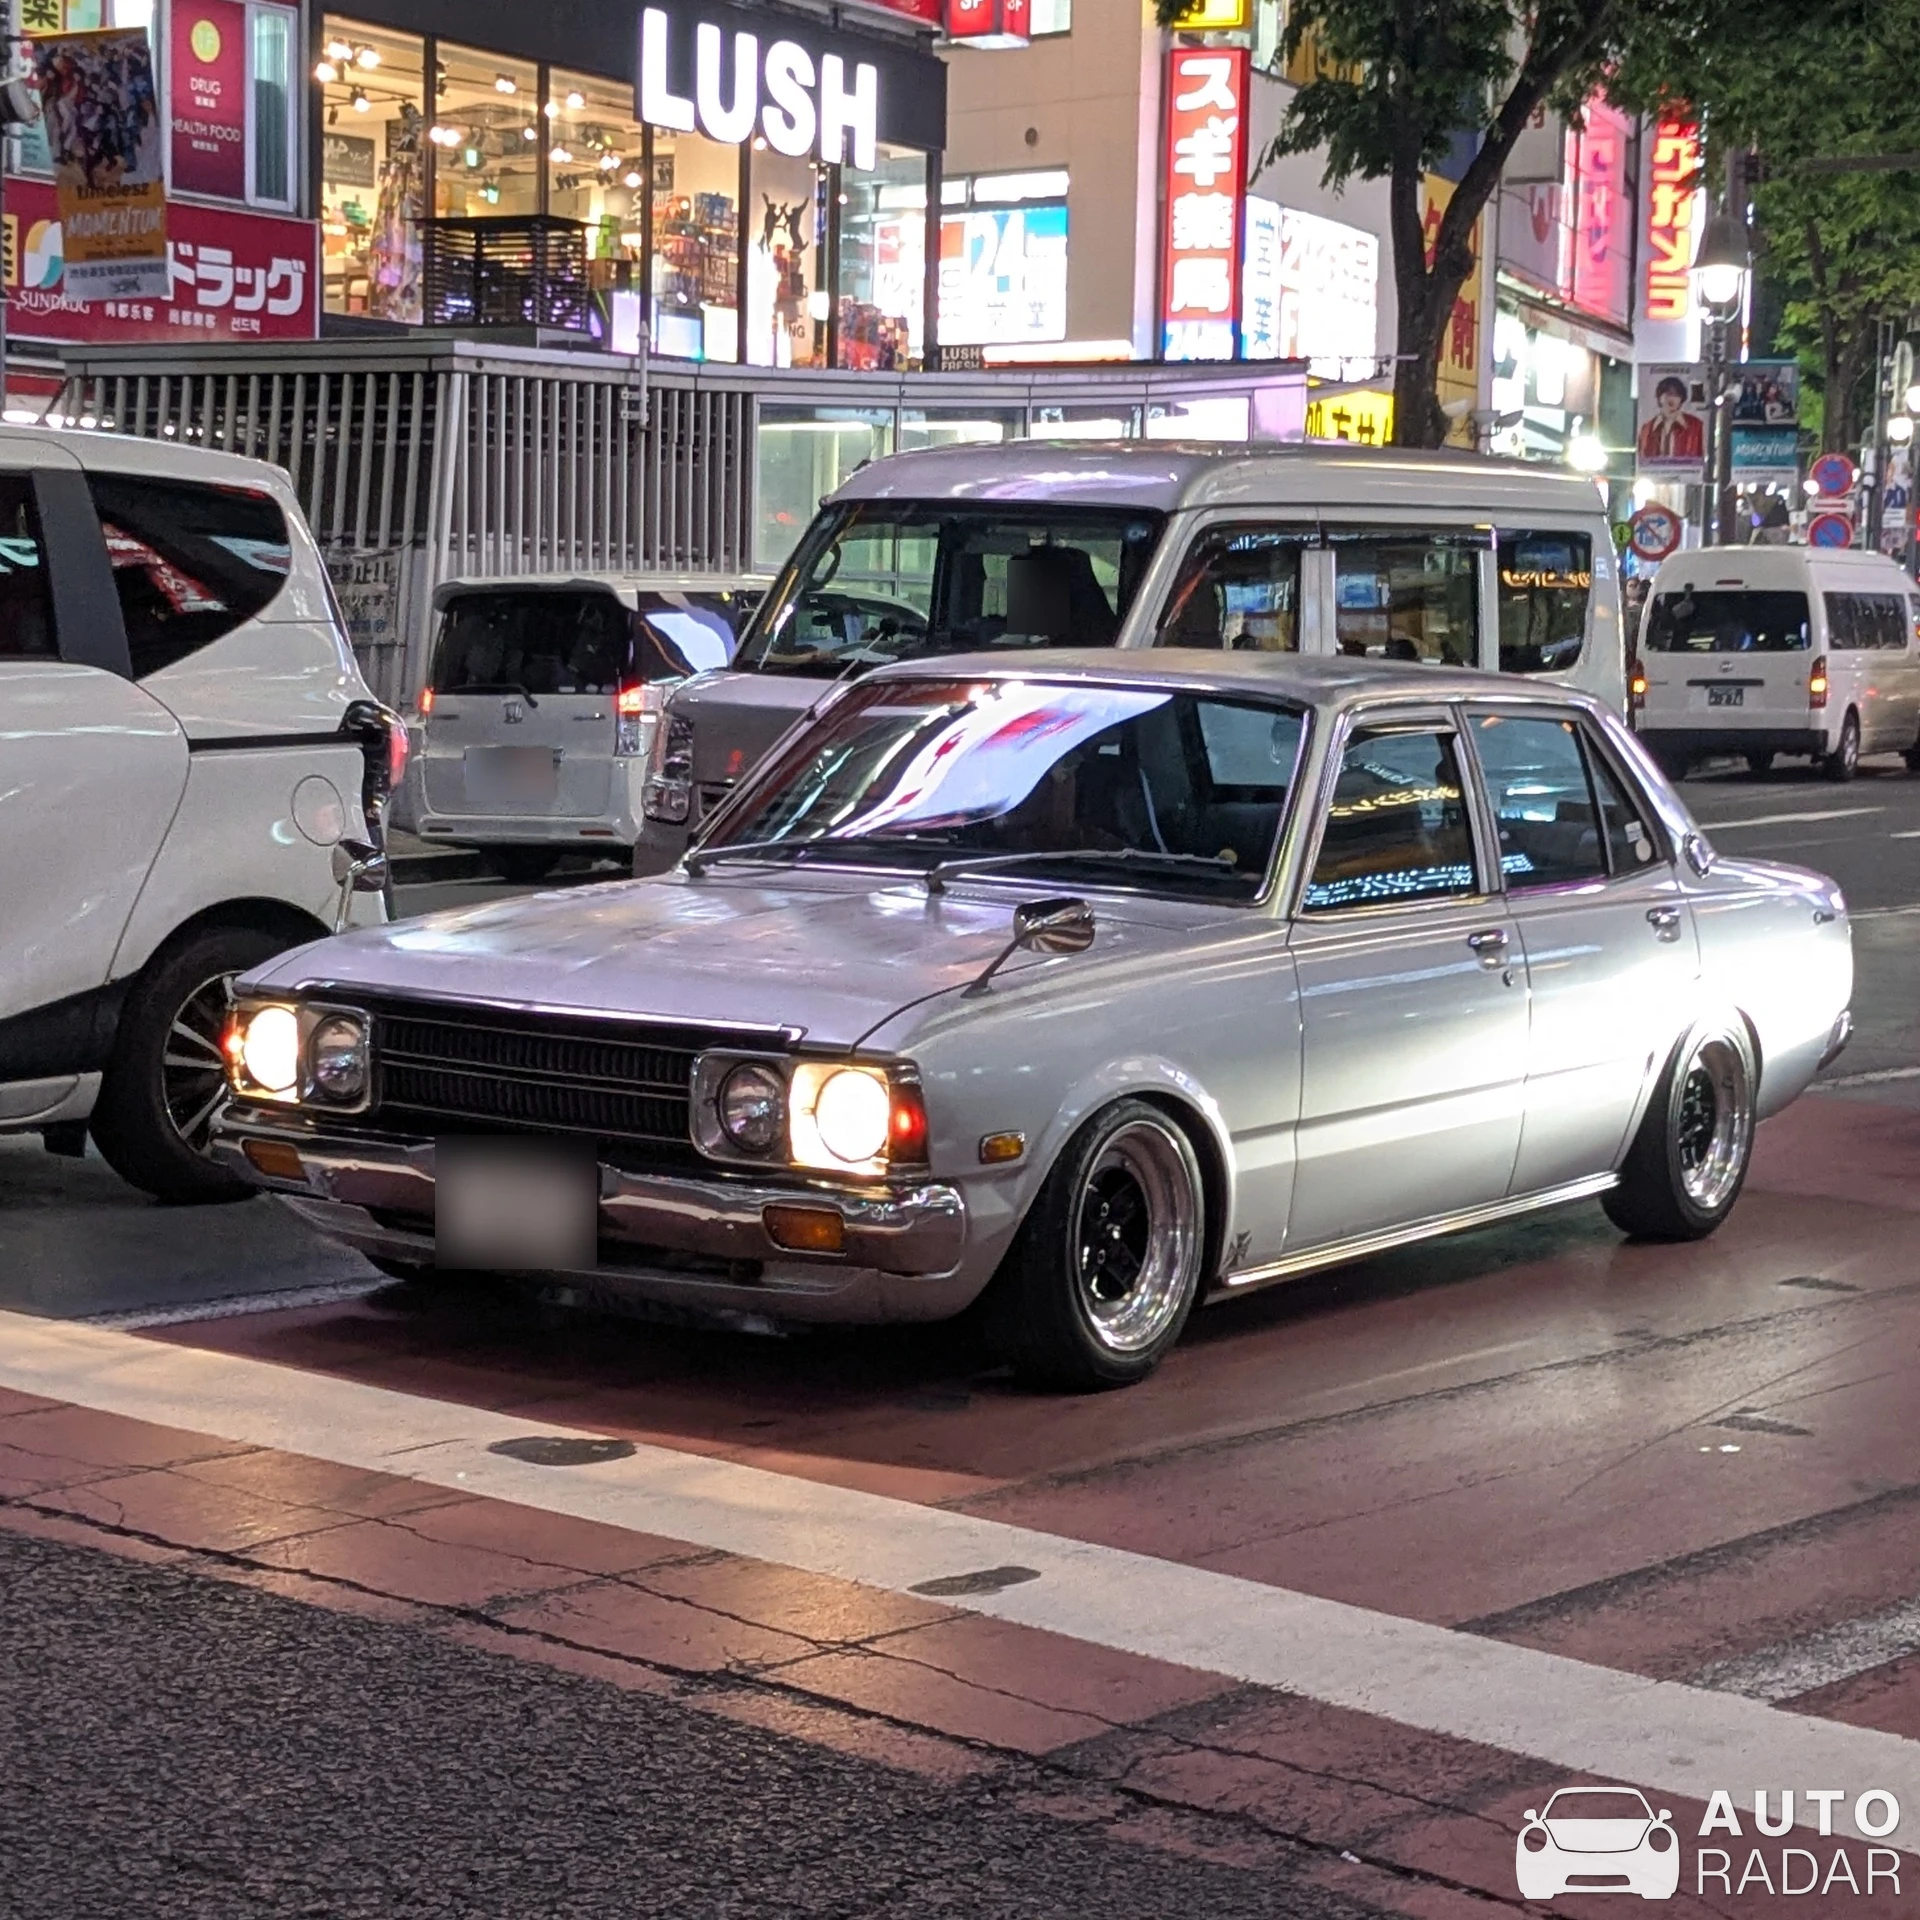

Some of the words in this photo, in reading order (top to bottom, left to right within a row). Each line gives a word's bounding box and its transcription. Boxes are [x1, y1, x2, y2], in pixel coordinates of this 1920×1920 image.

[190, 77, 221, 95] DRUG
[642, 8, 877, 172] LUSH
[209, 124, 241, 142] FOOD
[1171, 57, 1237, 313] スギ薬局
[66, 206, 162, 238] MOMENTUM
[941, 347, 980, 360] LUSH
